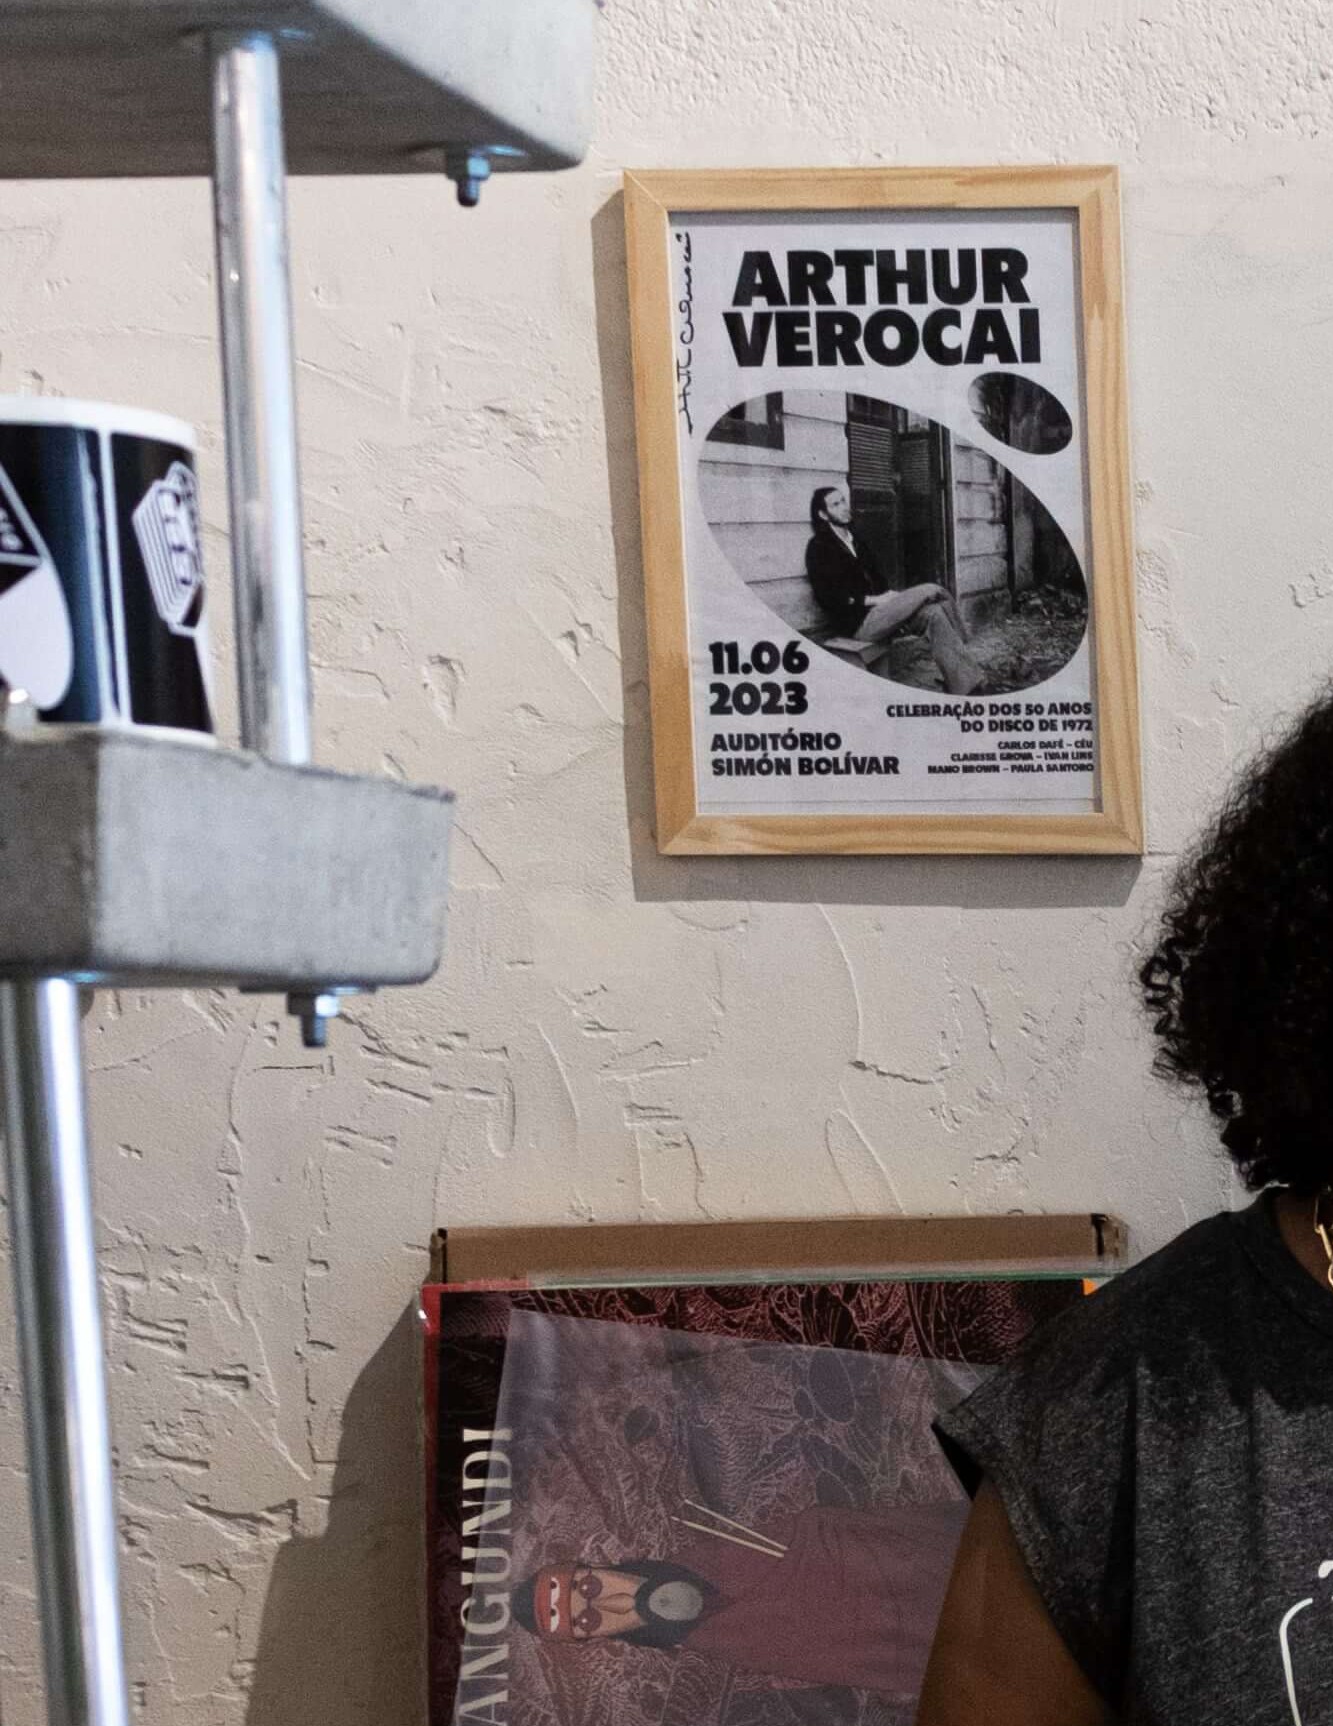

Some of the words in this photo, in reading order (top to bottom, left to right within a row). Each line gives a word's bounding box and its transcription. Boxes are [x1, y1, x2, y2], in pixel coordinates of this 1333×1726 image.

[731, 247, 1030, 307] ARTHUR
[721, 308, 1042, 368] VEROCAI
[708, 640, 810, 675] 11.06
[709, 681, 809, 716] 2023
[886, 701, 985, 720] CELEBRAÇÃO
[988, 703, 1021, 717] DOS
[1024, 702, 1045, 716] 50
[1047, 702, 1092, 716] ANOS
[960, 720, 985, 733] DO
[988, 719, 1035, 733] DISCO
[1038, 719, 1058, 732] DE
[1062, 719, 1094, 732] 1972
[710, 727, 842, 752] AUDITÓRIO
[997, 740, 1036, 750] CARLOS
[1074, 738, 1093, 750] CÉU
[711, 752, 792, 777] SIMÓN
[798, 751, 900, 776] BOLÍVAR
[927, 764, 960, 774] MANO
[962, 764, 1000, 774] BROWN
[1010, 763, 1044, 773] PAULA
[1044, 751, 1069, 761] IVAN
